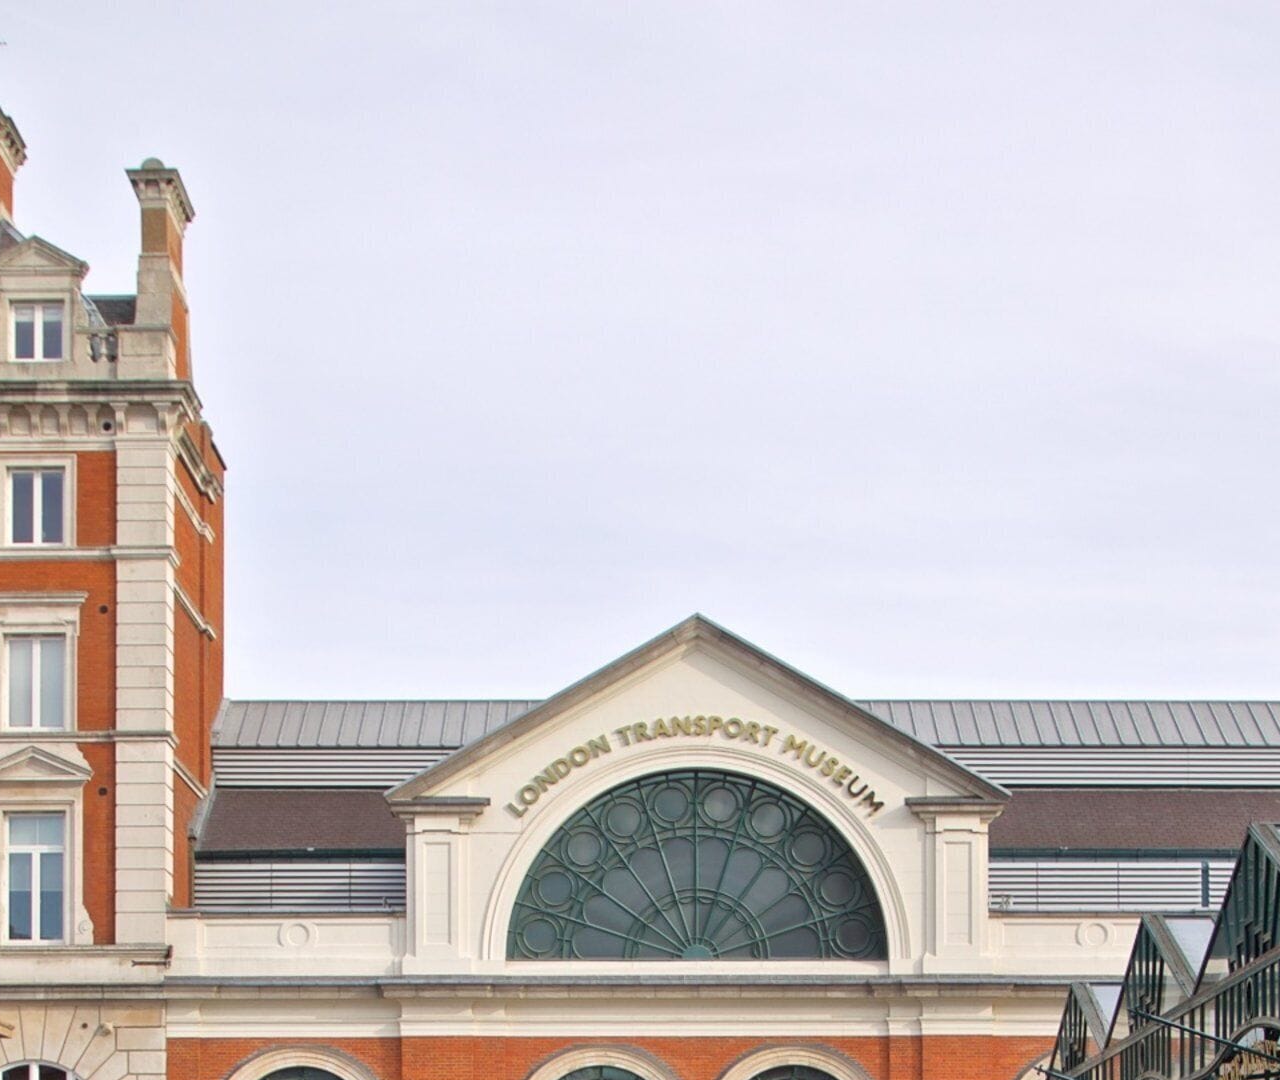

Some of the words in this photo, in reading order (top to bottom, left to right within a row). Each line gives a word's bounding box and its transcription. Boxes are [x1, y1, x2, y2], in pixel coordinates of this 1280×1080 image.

[507, 735, 612, 818] LONDON
[615, 715, 779, 747] TRANSPORT
[783, 734, 885, 818] MUSEUM
